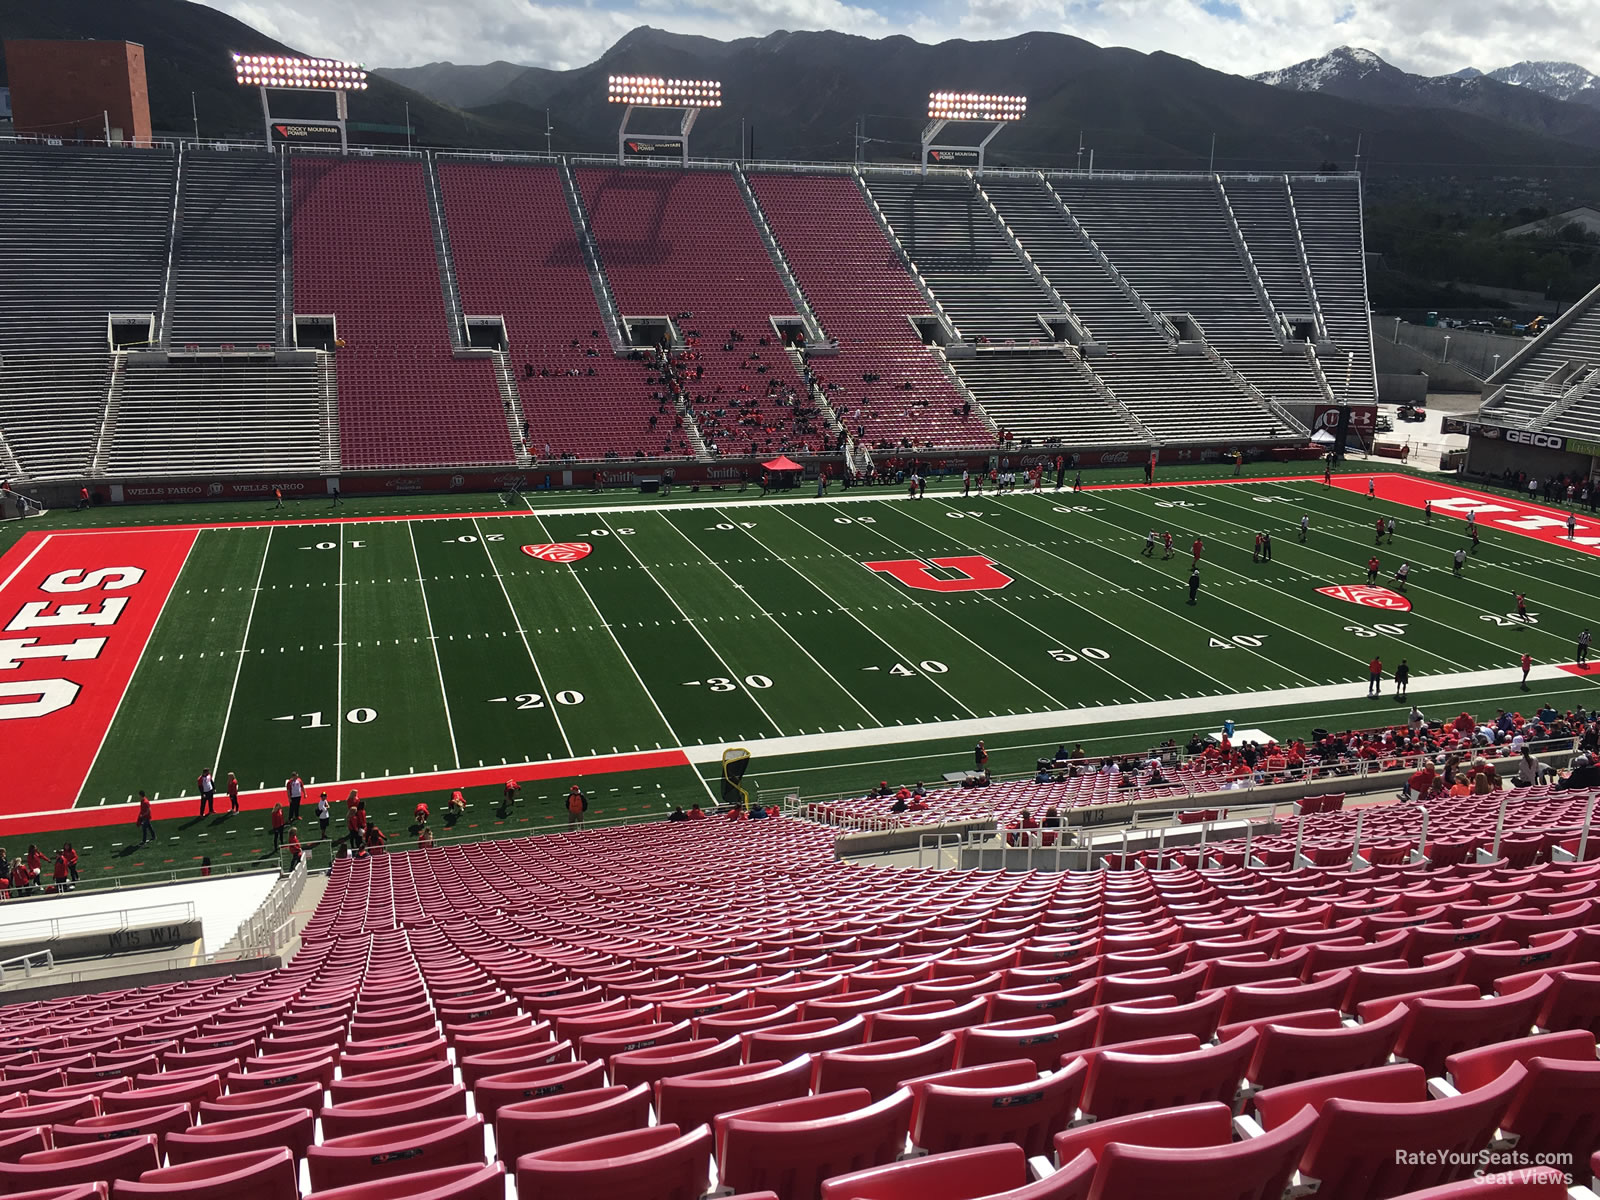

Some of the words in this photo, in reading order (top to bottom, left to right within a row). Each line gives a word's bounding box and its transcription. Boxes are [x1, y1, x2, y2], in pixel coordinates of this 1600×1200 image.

[1506, 429, 1562, 449] GEICO
[706, 466, 741, 479] Smith's
[128, 487, 165, 496] WELLS
[167, 486, 202, 495] FARGO
[232, 484, 270, 493] WELLS
[271, 483, 304, 492] FARGO
[833, 516, 877, 524] 50
[945, 511, 984, 519] 40
[590, 527, 636, 537] 30
[715, 521, 757, 531] 40
[315, 540, 367, 550] 10
[457, 533, 506, 543] 20
[861, 555, 1015, 593] U
[1479, 612, 1539, 627] 20
[1343, 623, 1406, 638] 30
[0, 566, 146, 720] UTES
[1208, 634, 1264, 650] 40
[1047, 646, 1111, 663] 50
[888, 660, 950, 678] 40
[705, 674, 774, 693] 30
[514, 689, 585, 710] 20
[300, 706, 378, 729] 10
